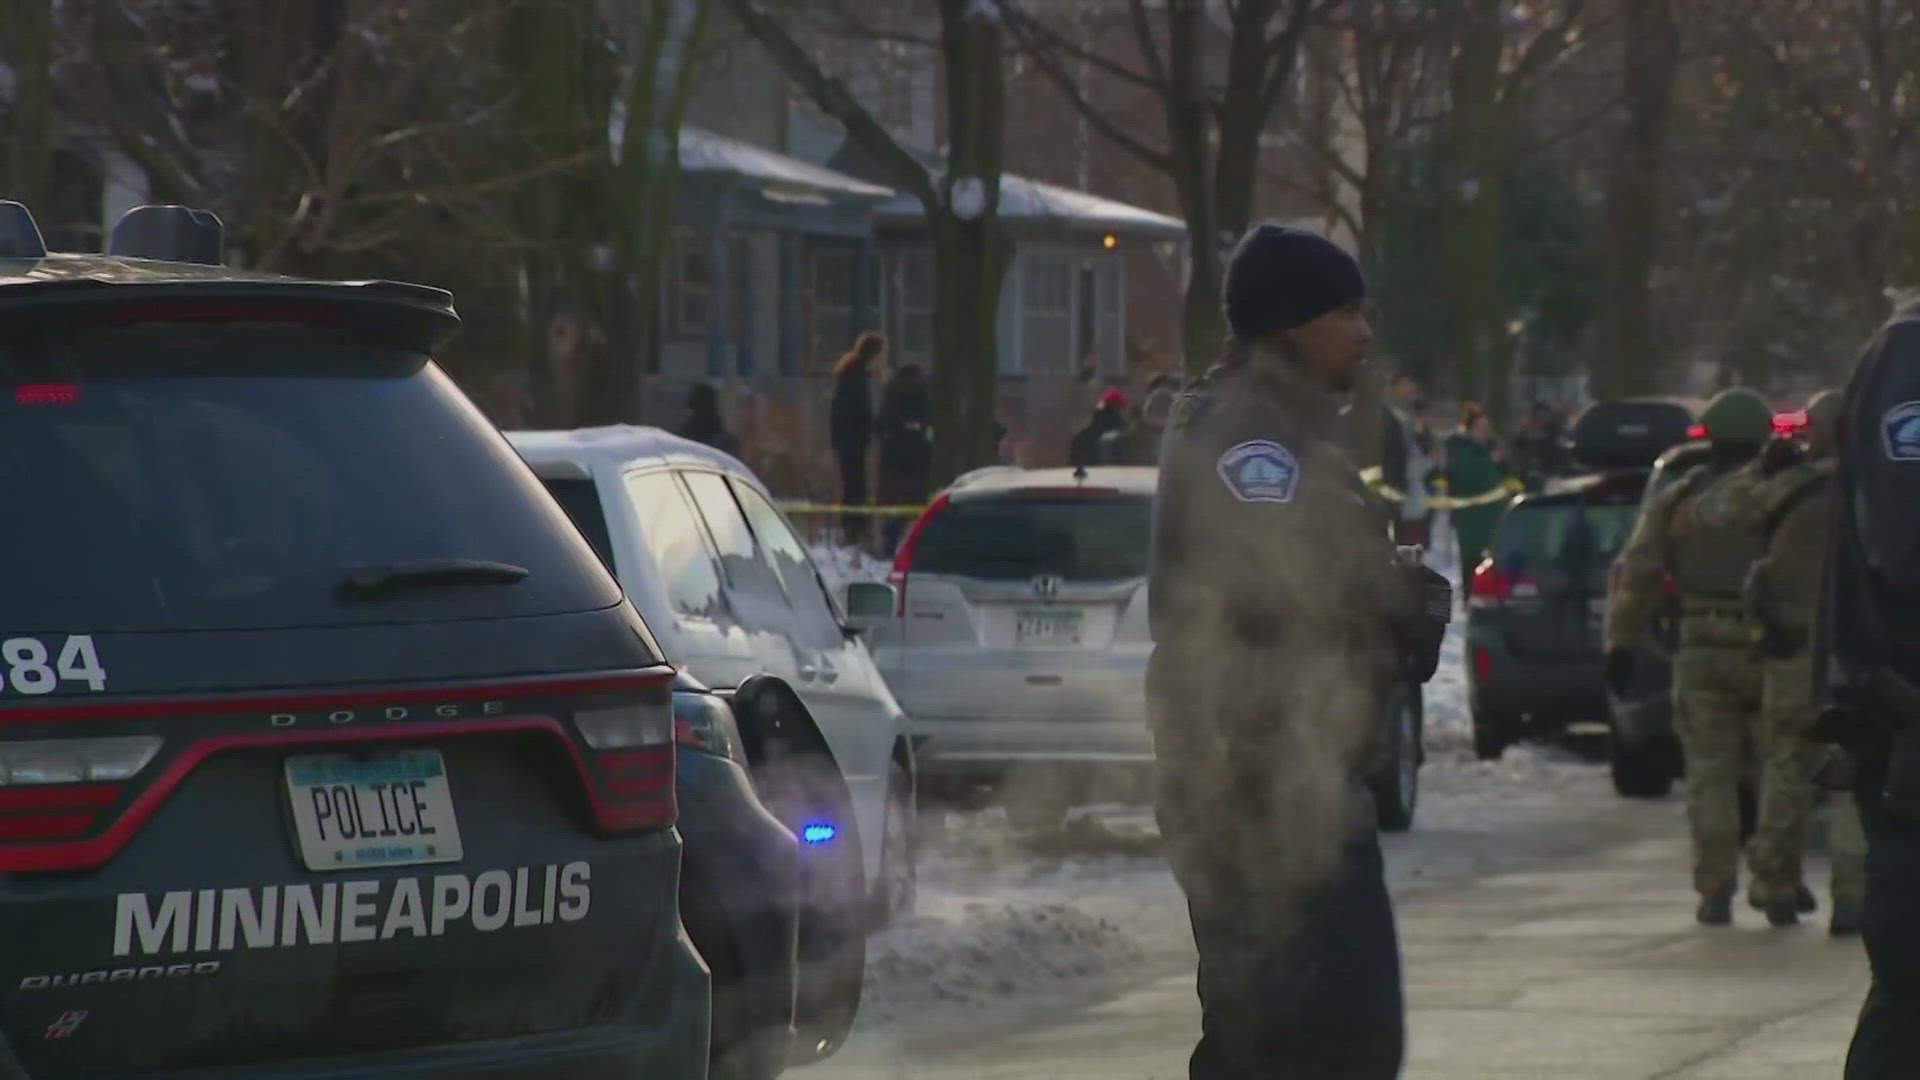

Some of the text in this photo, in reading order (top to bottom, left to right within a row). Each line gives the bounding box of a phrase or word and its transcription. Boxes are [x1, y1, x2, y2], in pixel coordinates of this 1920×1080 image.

[0, 634, 106, 694] 84
[271, 702, 503, 727] DODGE
[311, 781, 436, 841] POLICE
[113, 861, 591, 956] MINNEAPOLIS
[19, 961, 220, 990] DURANGO
